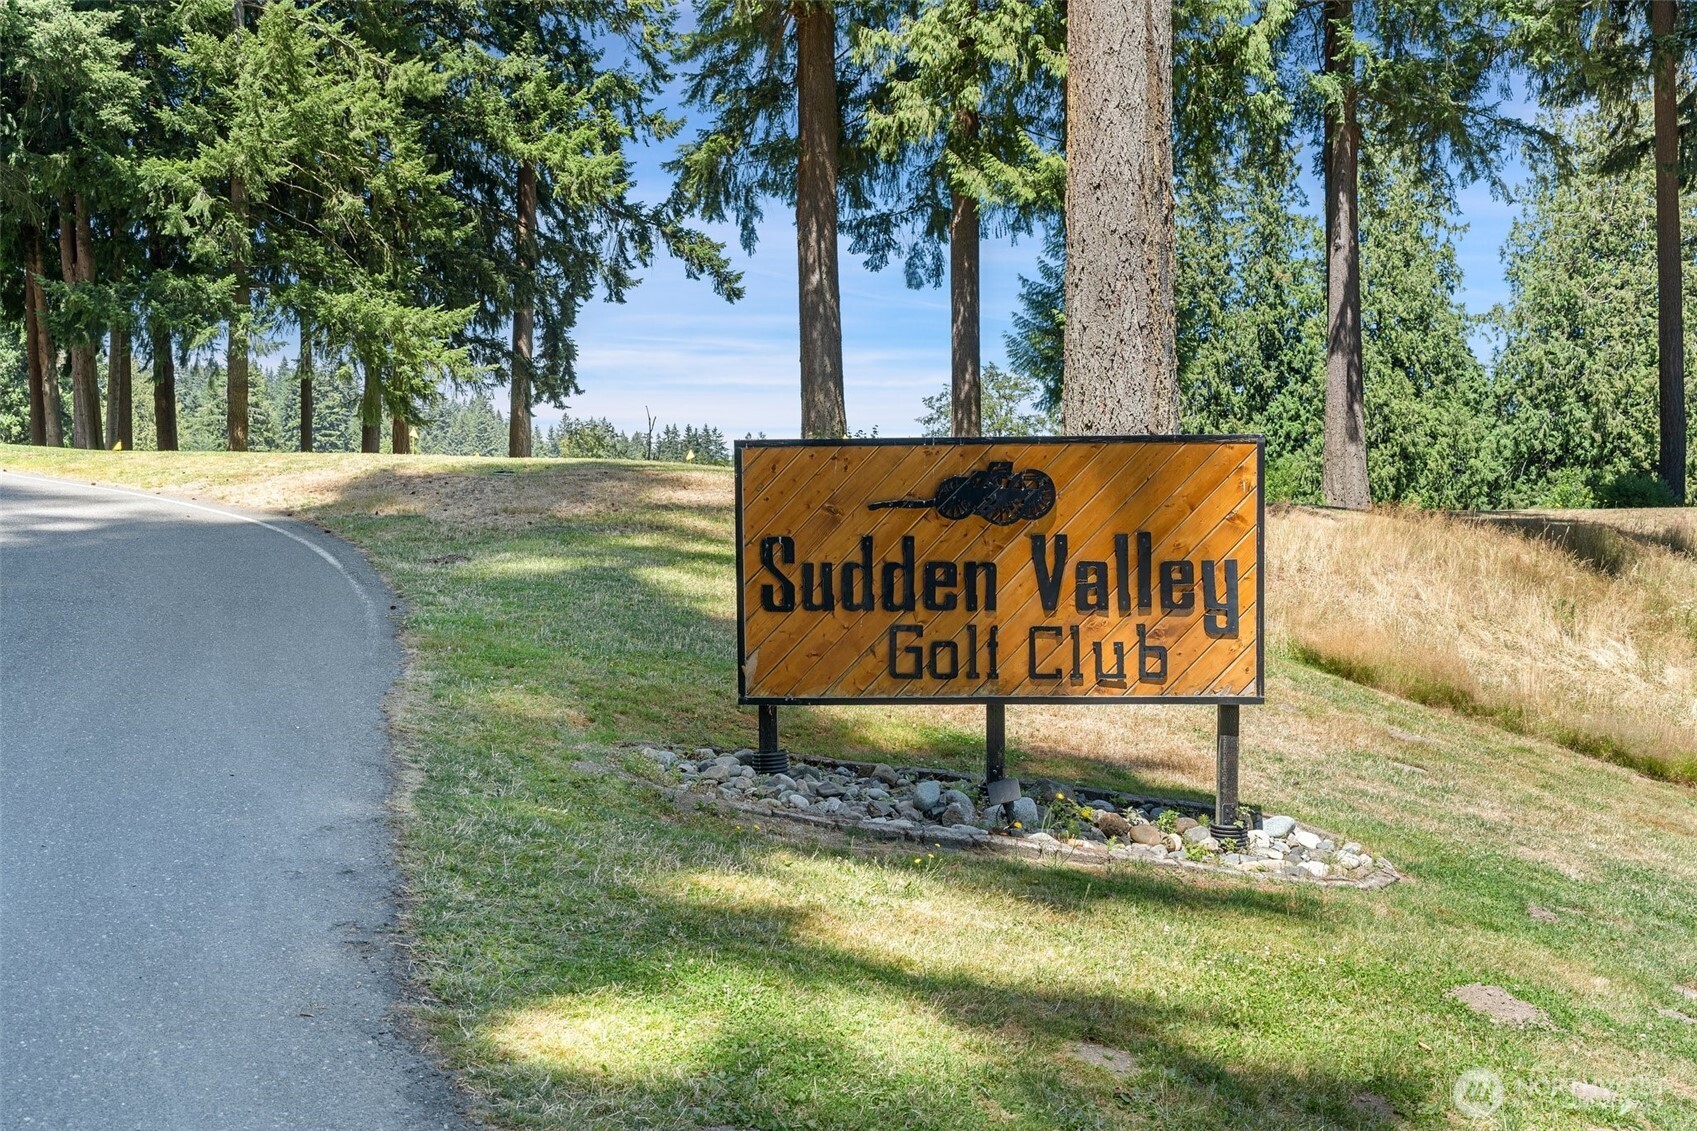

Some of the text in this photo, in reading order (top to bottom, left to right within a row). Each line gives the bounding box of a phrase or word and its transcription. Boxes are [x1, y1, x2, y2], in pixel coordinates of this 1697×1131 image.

[760, 531, 1239, 638] Sudden Valley
[888, 623, 1168, 680] Golf Club
